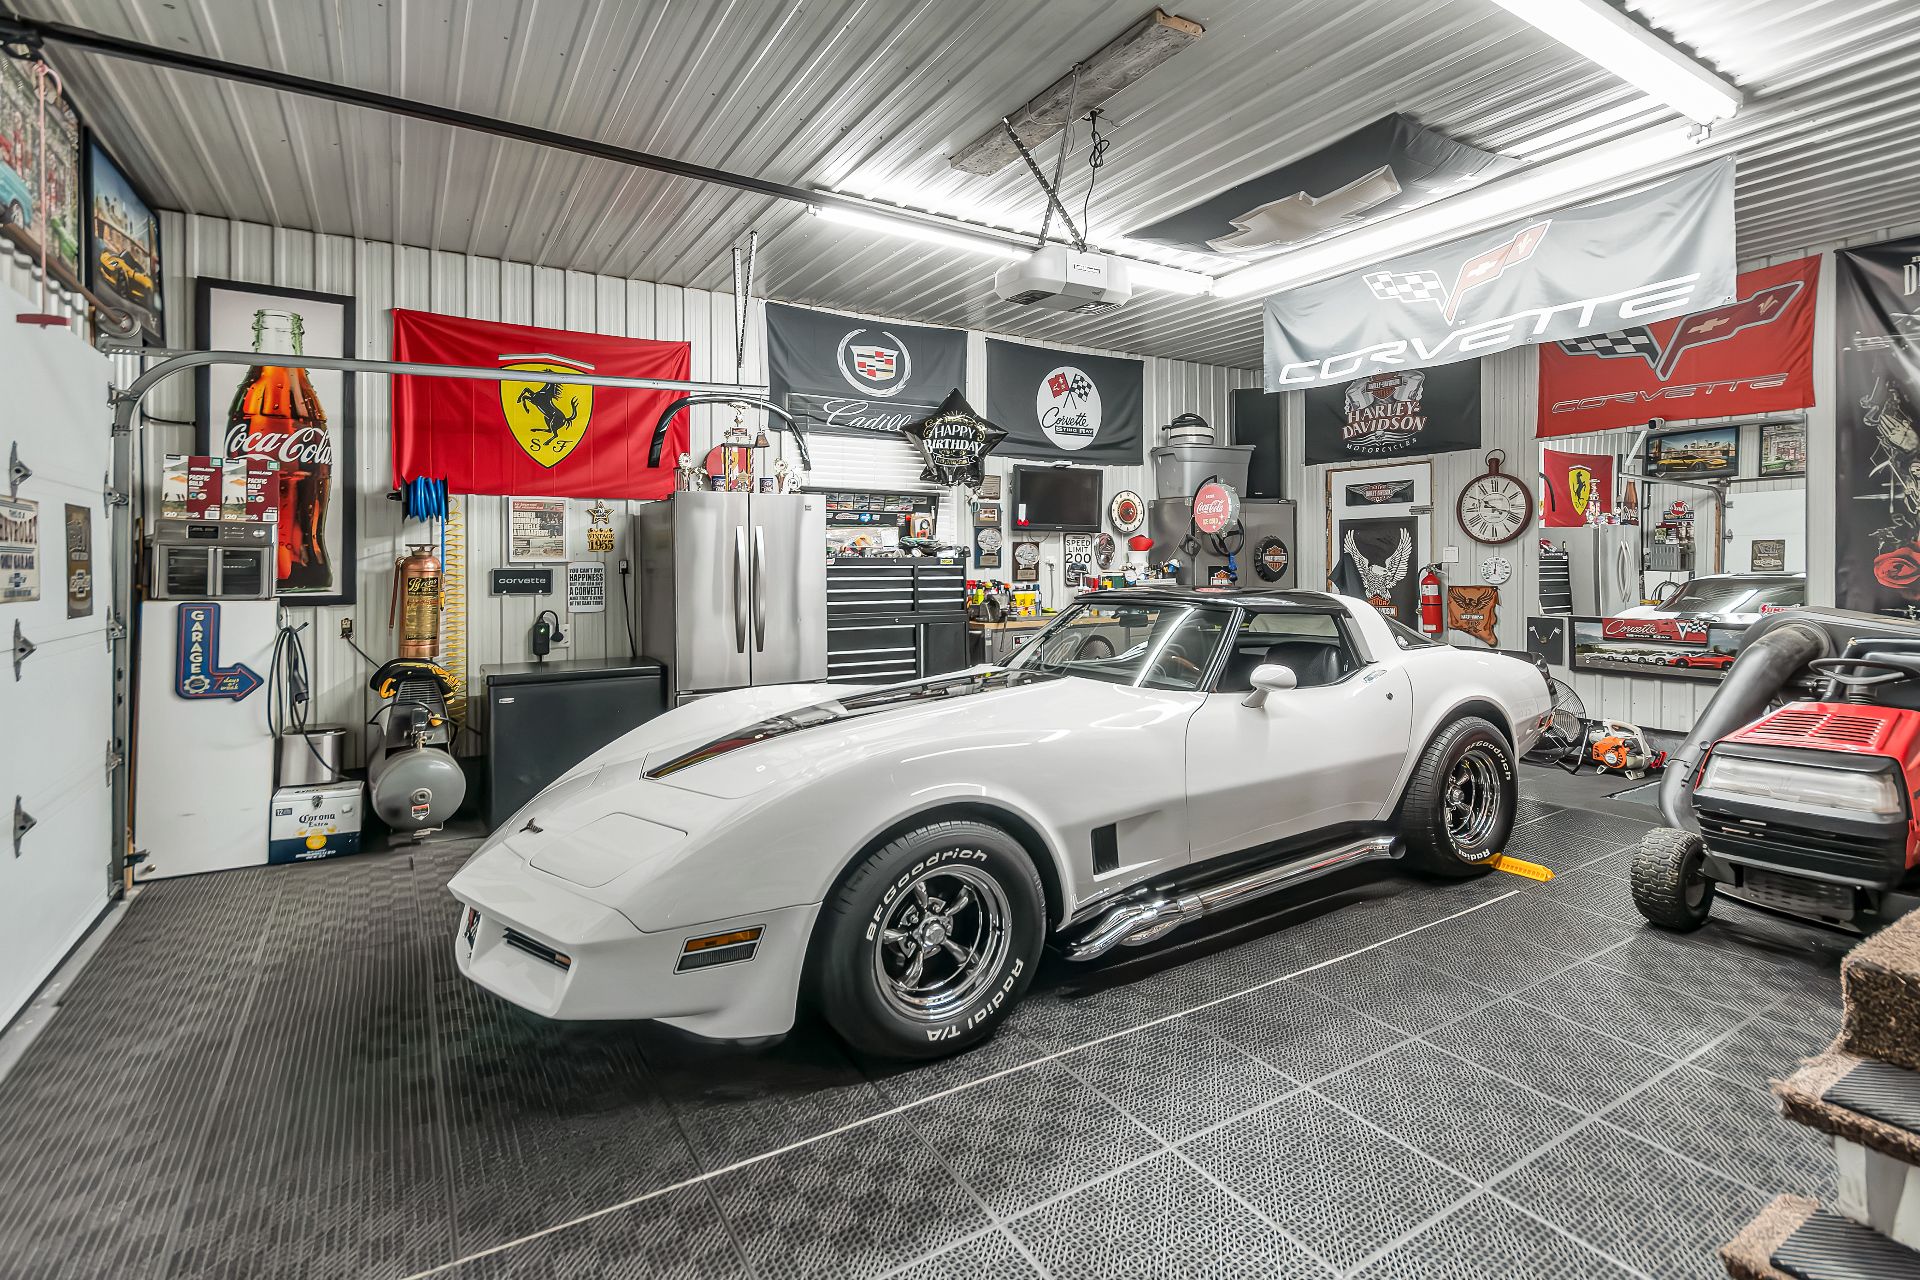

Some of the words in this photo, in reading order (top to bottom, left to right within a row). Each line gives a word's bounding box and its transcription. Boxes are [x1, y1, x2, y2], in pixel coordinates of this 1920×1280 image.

[1278, 272, 1702, 386] CORVETTE
[1552, 372, 1788, 413] CORVETTE
[823, 400, 912, 431] Cadill
[1042, 407, 1089, 428] Corvette
[935, 424, 976, 439] HAPPY
[1342, 416, 1427, 440] DAVIDSON
[224, 423, 332, 465] Coca-Cola
[530, 438, 541, 451] S
[553, 441, 573, 452] F
[922, 439, 986, 457] BIRTHDAY
[1197, 500, 1224, 514] Coca-Cola
[588, 540, 614, 550] 1955
[1065, 553, 1092, 563] 200
[569, 587, 573, 595] A
[574, 587, 603, 595] CORVETTE
[1606, 620, 1657, 634] Corvette
[189, 610, 204, 674] GARAGE
[1464, 741, 1511, 781] BFGoodrich
[299, 813, 336, 824] Corona
[1458, 848, 1491, 861] Radial
[866, 847, 988, 942] BFGoodrich
[967, 957, 1024, 1030] Radial
[926, 1028, 961, 1042] T/A
